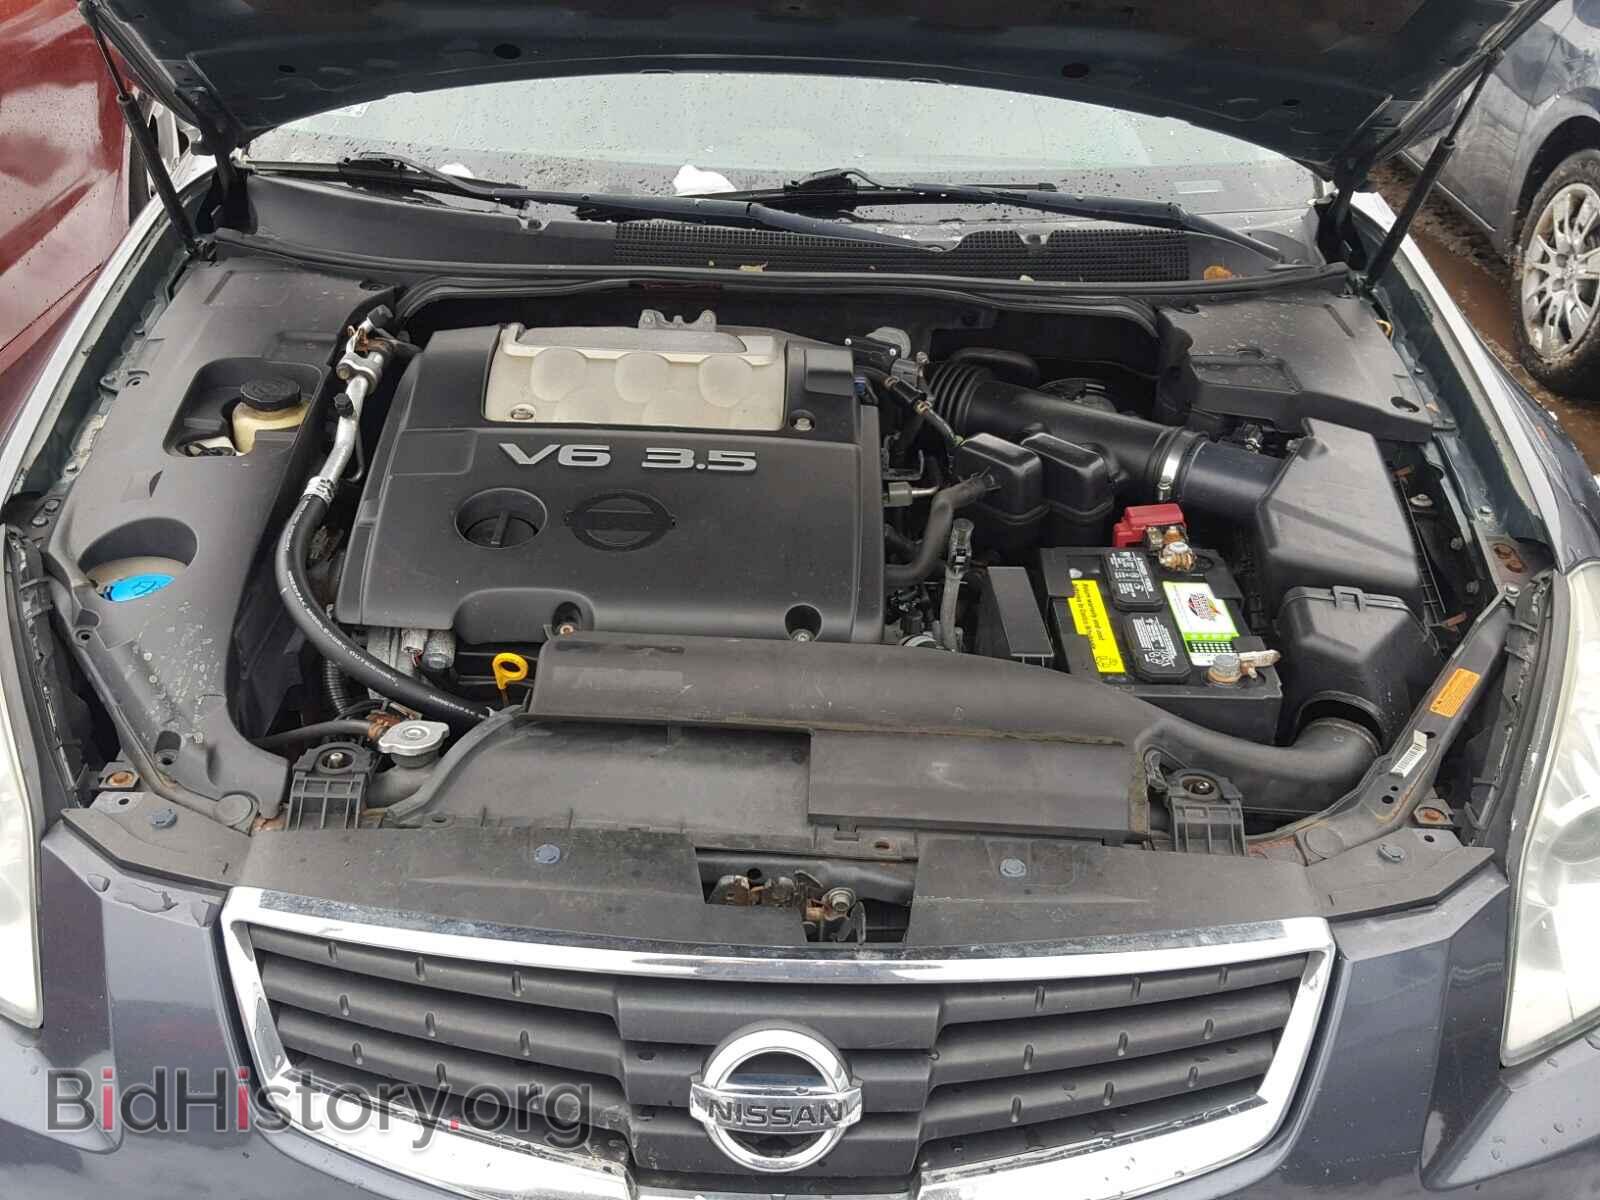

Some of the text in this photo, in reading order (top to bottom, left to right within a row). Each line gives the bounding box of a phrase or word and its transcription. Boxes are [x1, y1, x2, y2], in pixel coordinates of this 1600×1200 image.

[499, 443, 757, 472] V6 3.5
[707, 1099, 842, 1127] NISSAN
